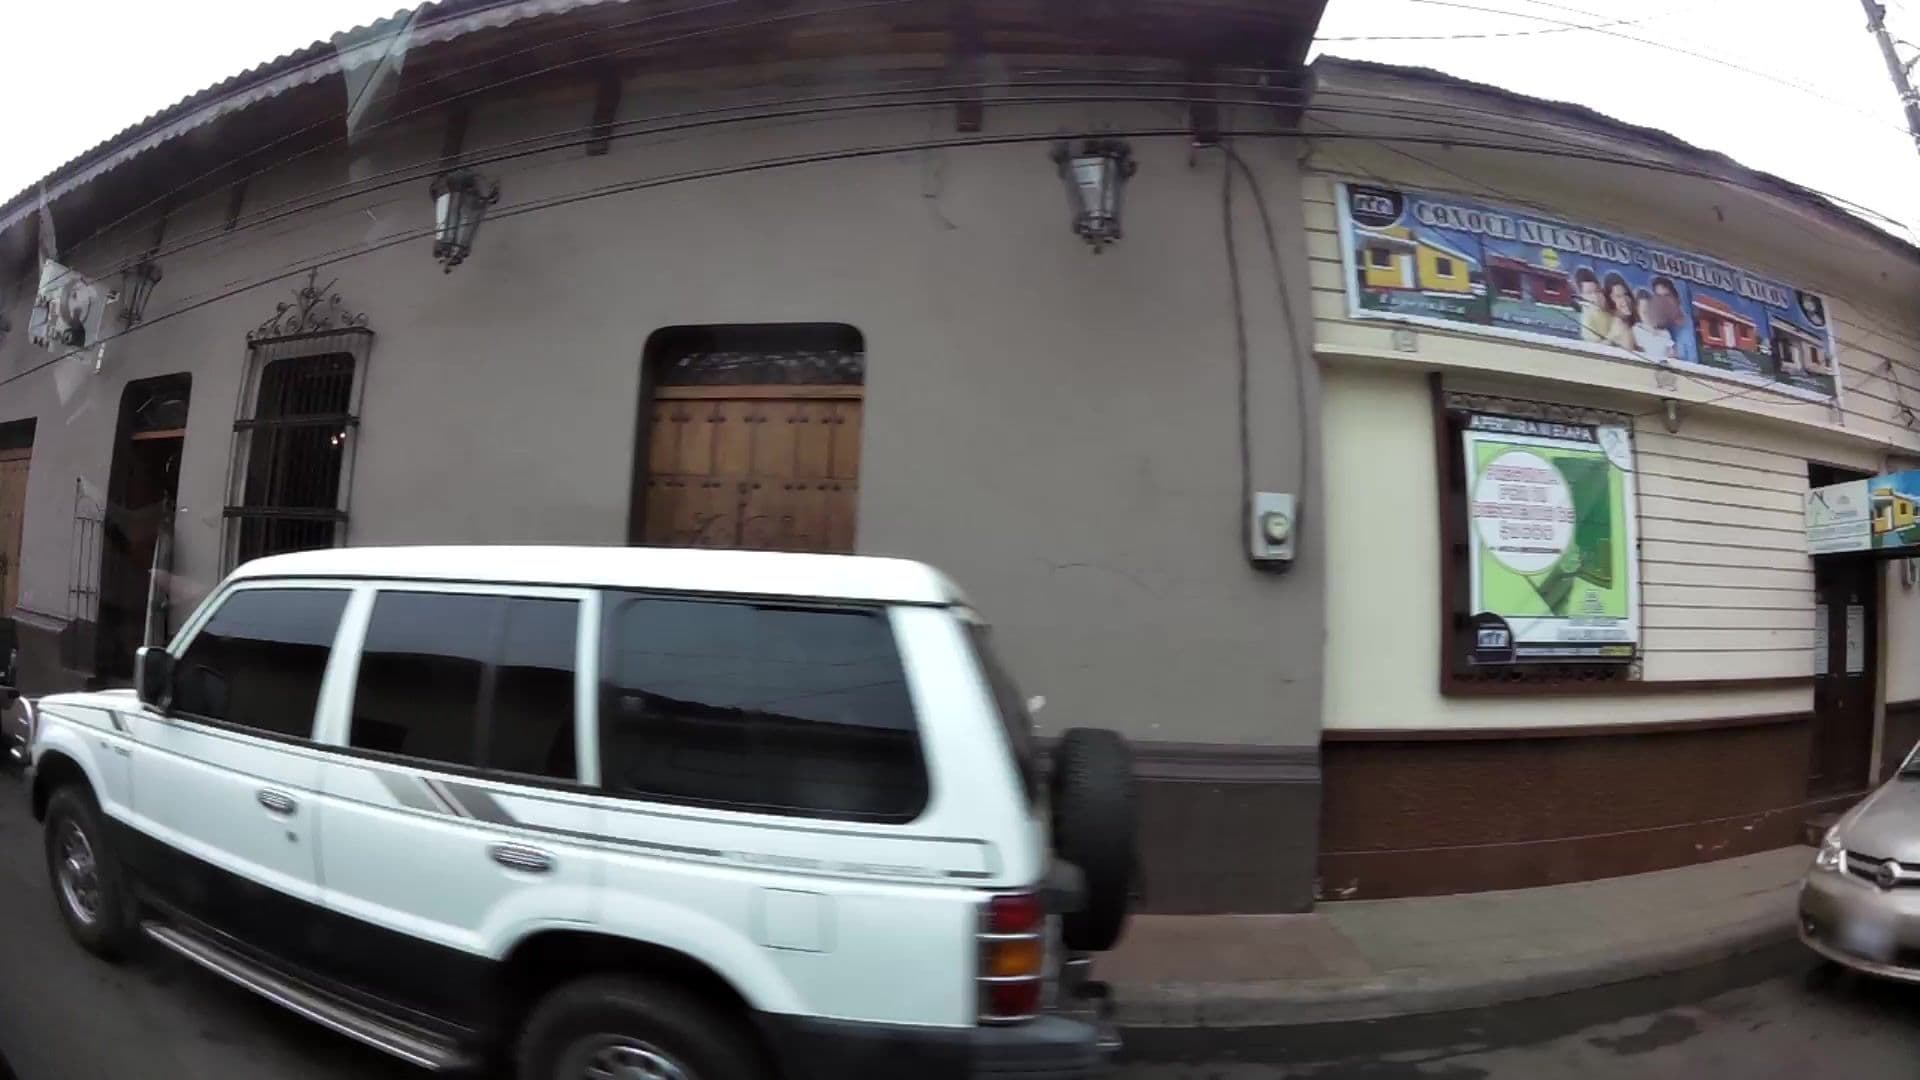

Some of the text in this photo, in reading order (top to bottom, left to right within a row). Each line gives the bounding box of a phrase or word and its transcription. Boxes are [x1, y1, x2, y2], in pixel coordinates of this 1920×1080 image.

[1415, 200, 1515, 240] CONOCE
[1518, 219, 1631, 264] NUESTROS
[1651, 250, 1734, 292] MODELOS
